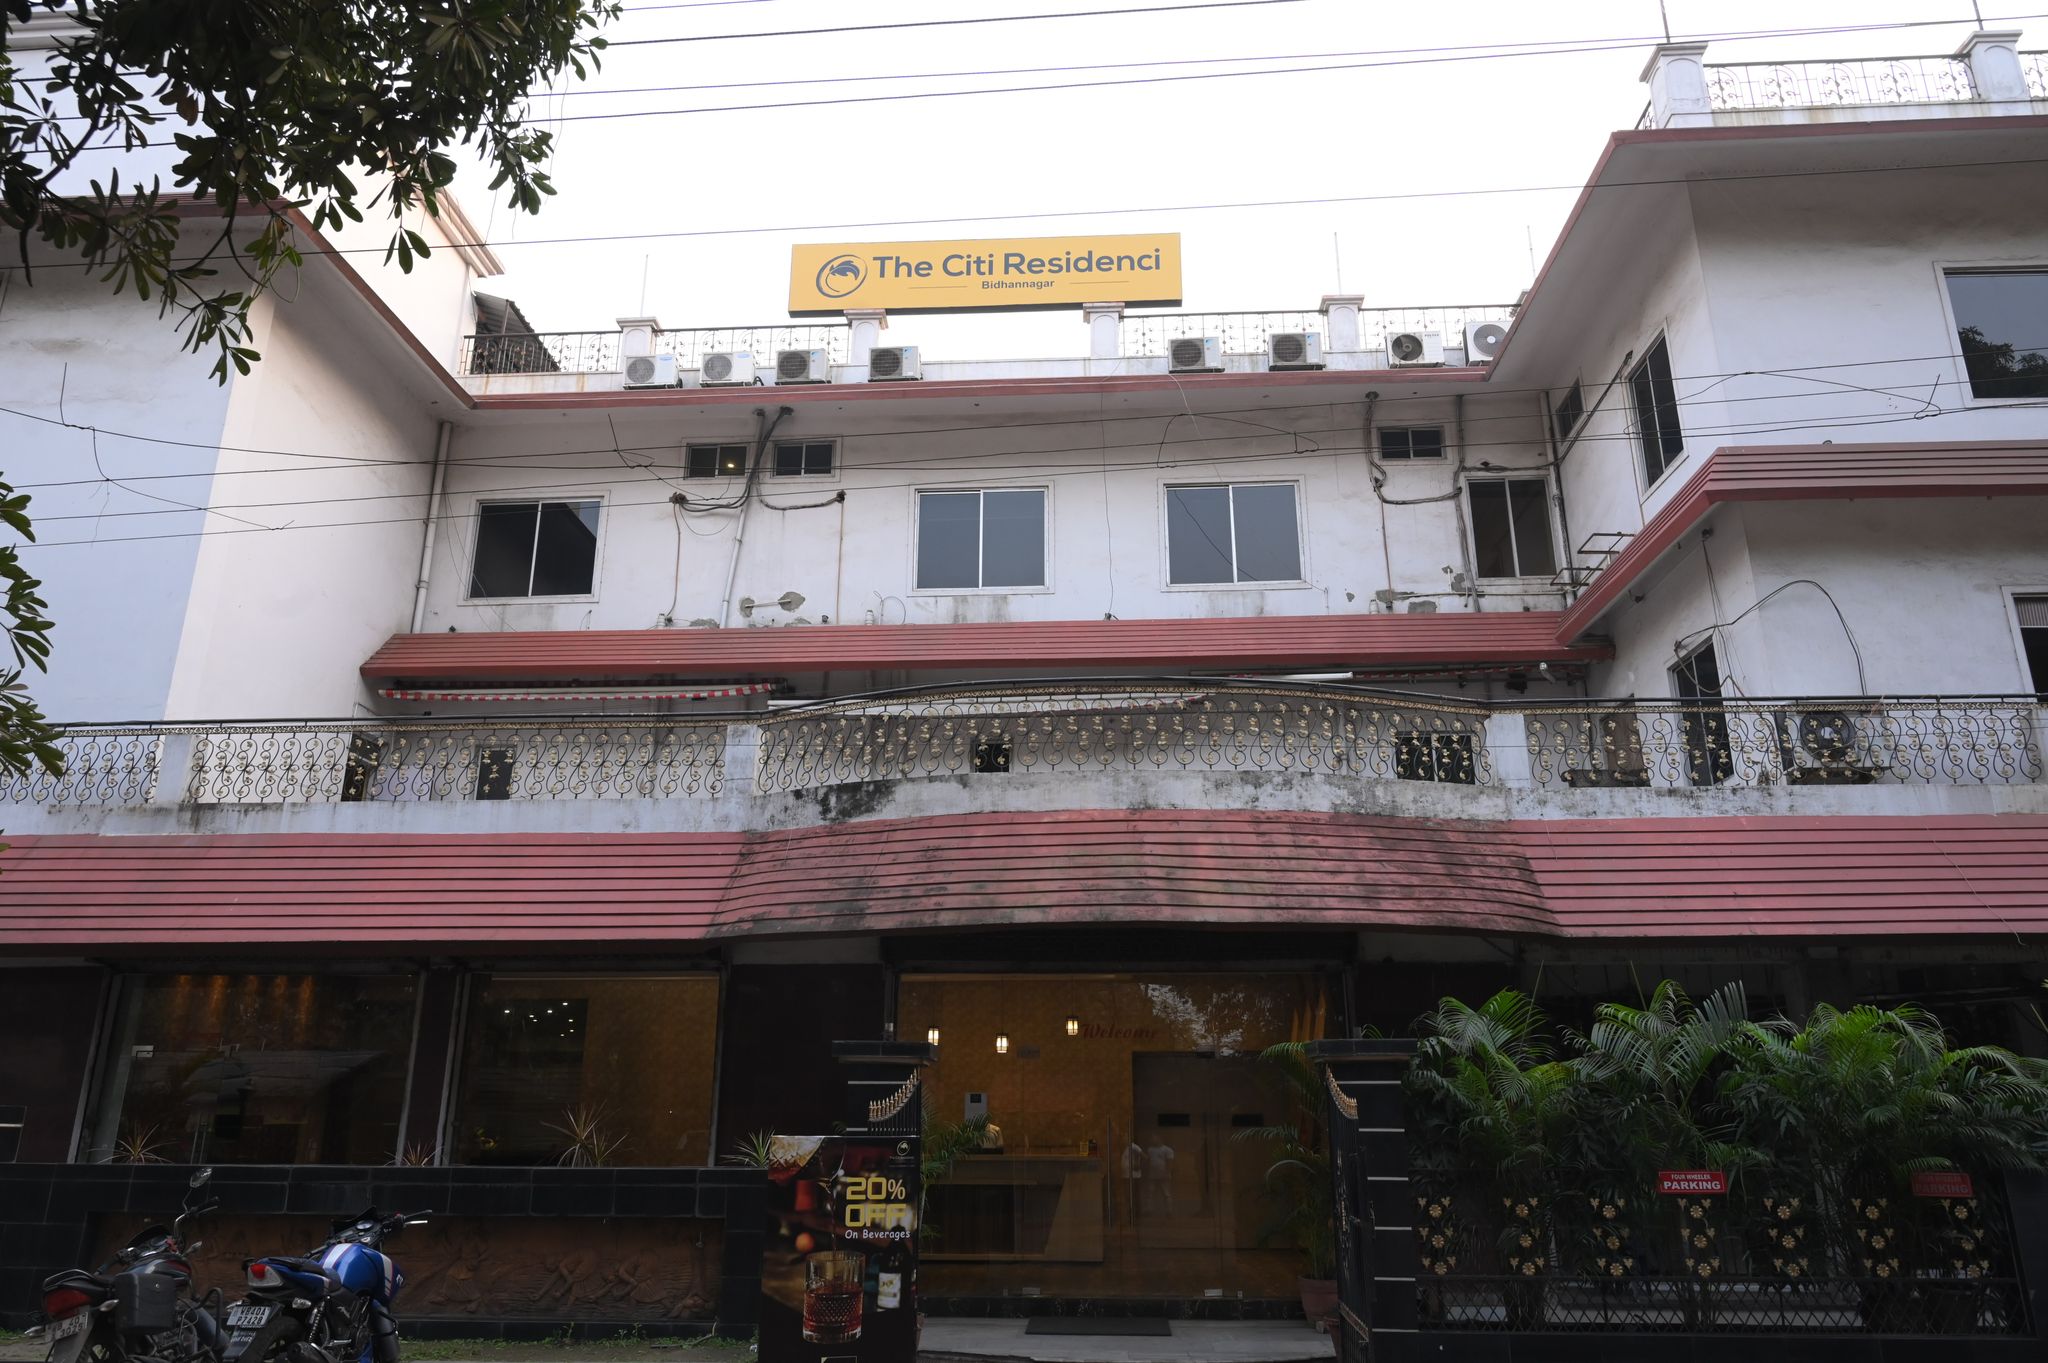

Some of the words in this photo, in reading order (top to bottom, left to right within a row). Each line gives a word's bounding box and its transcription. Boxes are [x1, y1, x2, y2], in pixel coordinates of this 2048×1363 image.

[872, 255, 934, 279] The
[942, 251, 995, 277] Citi
[1003, 247, 1162, 275] Residenci
[981, 278, 1056, 291] Bidhannagar
[1082, 1022, 1159, 1040] Welcome
[846, 1177, 906, 1200] 20%
[1663, 1181, 1721, 1190] PARKING
[1915, 1184, 1969, 1193] PARKING
[845, 1203, 907, 1229] OFF
[845, 1229, 858, 1239] On
[862, 1229, 911, 1241] Beverages
